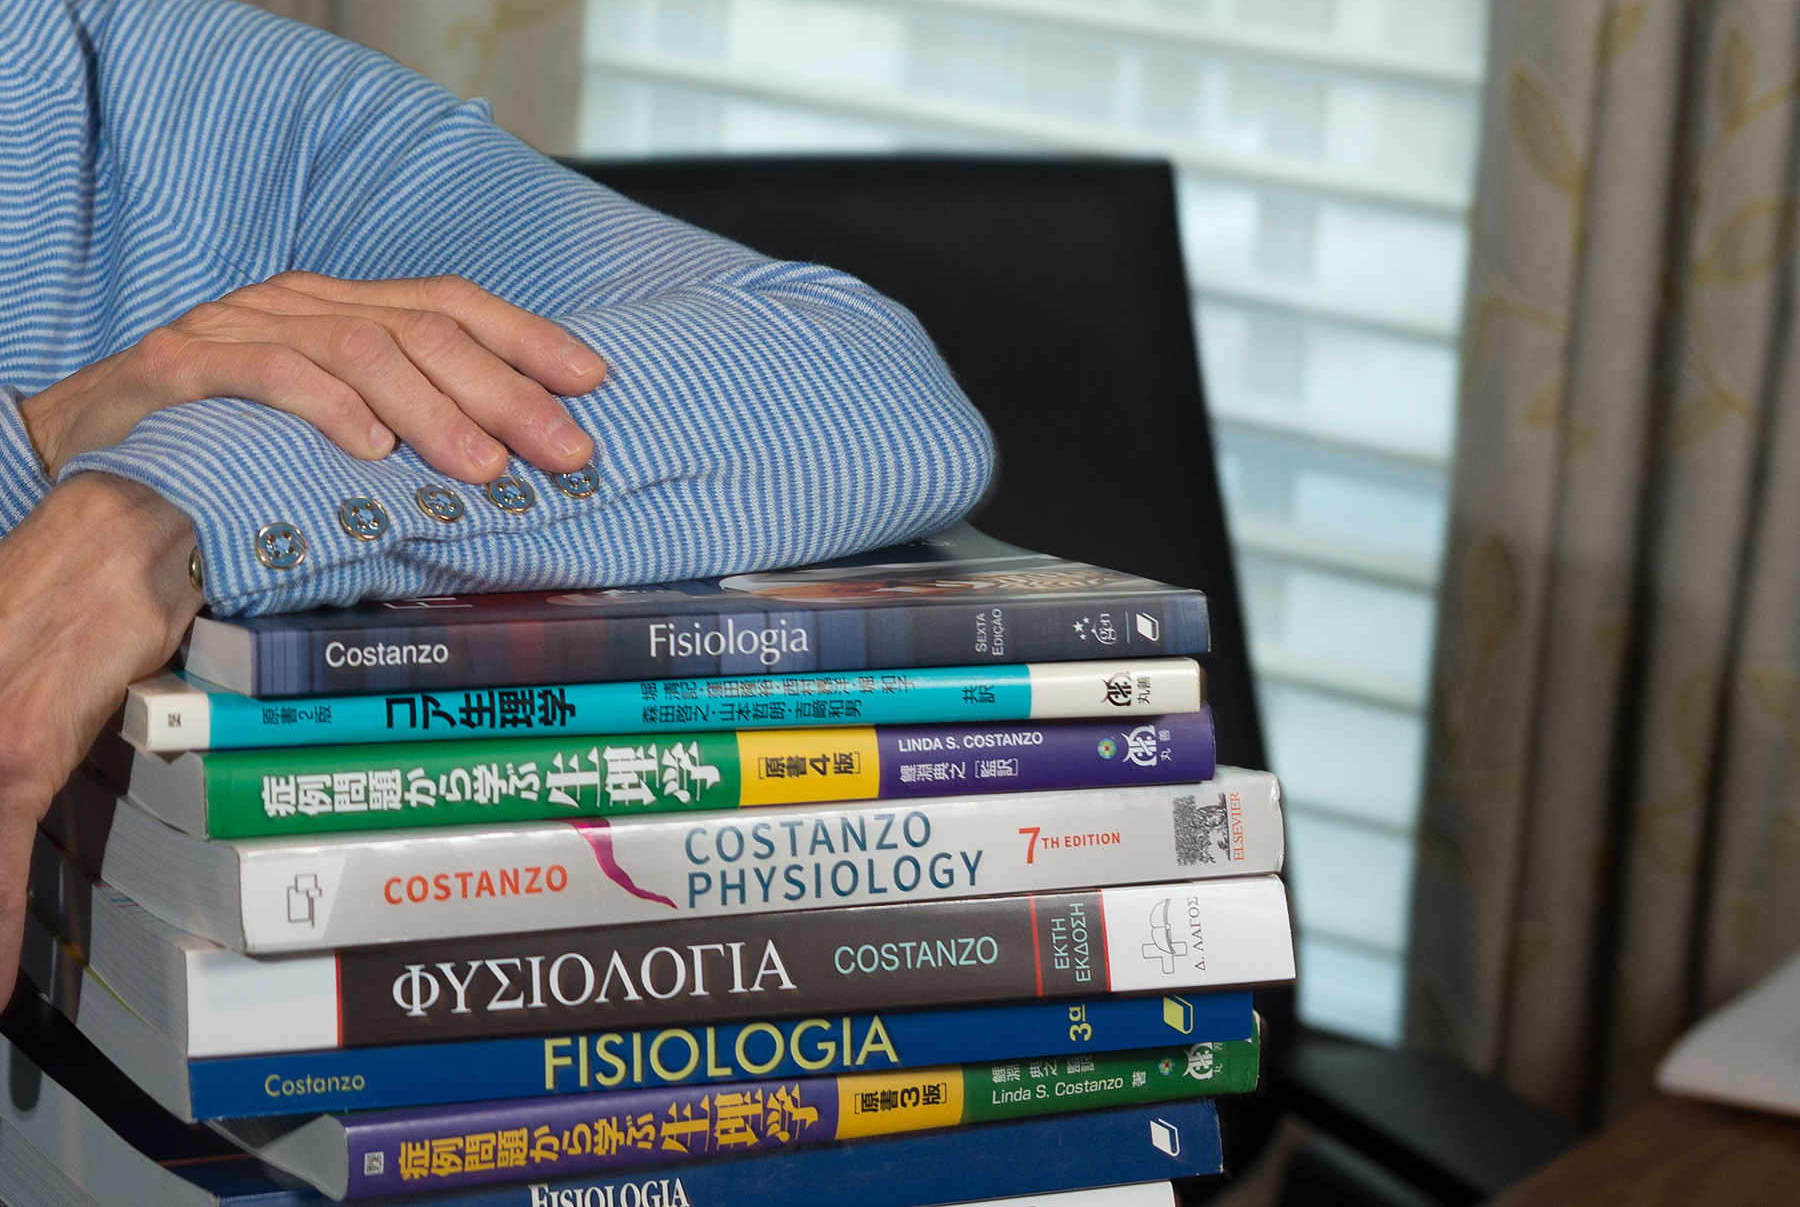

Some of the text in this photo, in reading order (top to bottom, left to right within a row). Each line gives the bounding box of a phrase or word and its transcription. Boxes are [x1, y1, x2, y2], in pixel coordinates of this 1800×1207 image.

[649, 618, 809, 666] Fisiologia
[975, 612, 988, 653] SEXTA
[324, 641, 449, 669] Costanzo
[385, 688, 577, 730] コア生理学
[961, 683, 997, 705] 共訳
[1137, 674, 1152, 705] 丸善
[262, 704, 332, 726] 原書2版
[898, 731, 1044, 753] LINDA S. COSTANZO
[1158, 728, 1172, 762] 丸善
[261, 739, 721, 818] 症例問題から学ぶ生理学
[684, 811, 932, 865] COSTANZO
[1018, 826, 1121, 864] 7TH EDITION
[1229, 791, 1245, 862] ELSEVIER
[384, 864, 569, 905] COSTANZO
[687, 850, 984, 910] PHYSIOLOGY
[1050, 917, 1070, 970] ΕΚΤΗ
[1069, 902, 1092, 982] ΕΚΔΟΣΗ
[1186, 896, 1204, 953] ΛΑΓΟΣ
[833, 935, 999, 976] COSTANZO
[392, 938, 798, 1018] ΦΥΣΙΟΛΟΓΙΑ
[543, 1014, 900, 1091] FISIOLOGIA
[264, 1072, 366, 1098] Costanzo
[991, 1070, 1148, 1105] Linda S. Costanzo 著
[399, 1082, 819, 1181] 症例問題から学ぶ生理学
